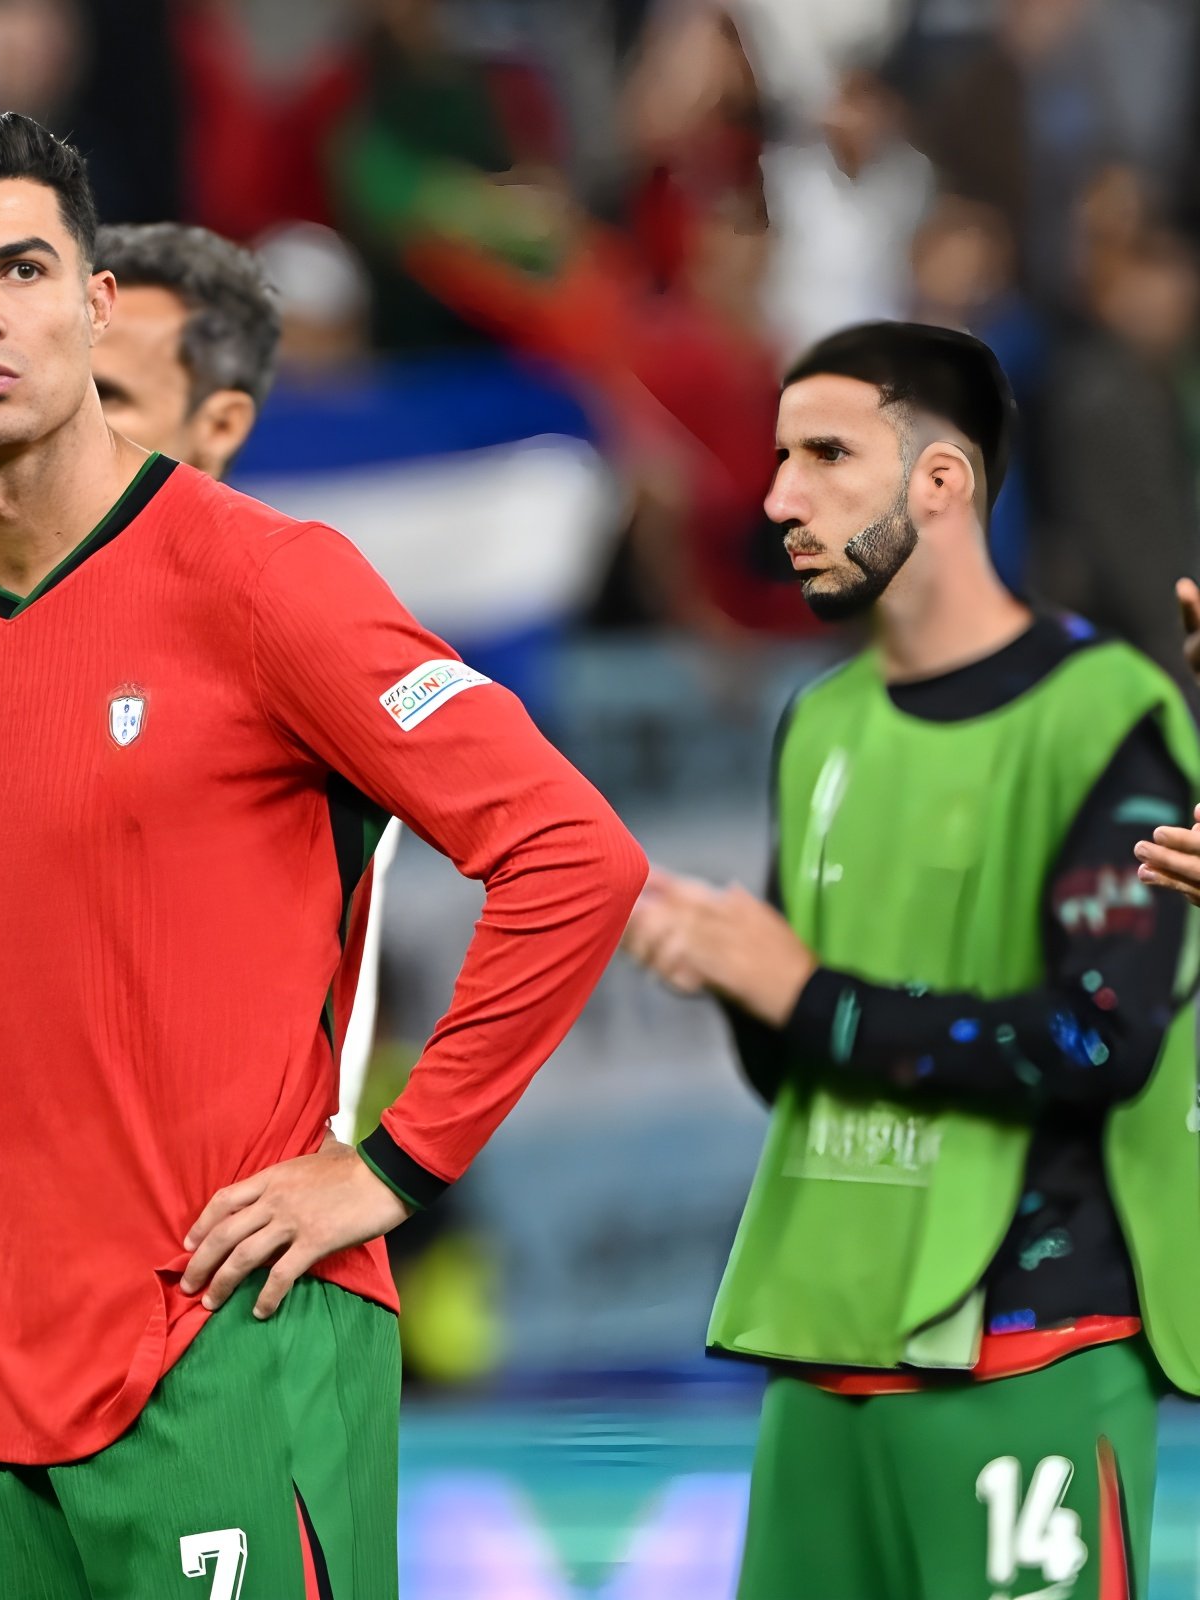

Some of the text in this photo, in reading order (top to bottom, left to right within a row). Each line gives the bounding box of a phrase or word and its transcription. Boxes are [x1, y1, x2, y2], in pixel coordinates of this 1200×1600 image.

[391, 667, 473, 719] FOUND
[976, 1455, 1089, 1586] 14
[179, 1527, 248, 1600] 7
